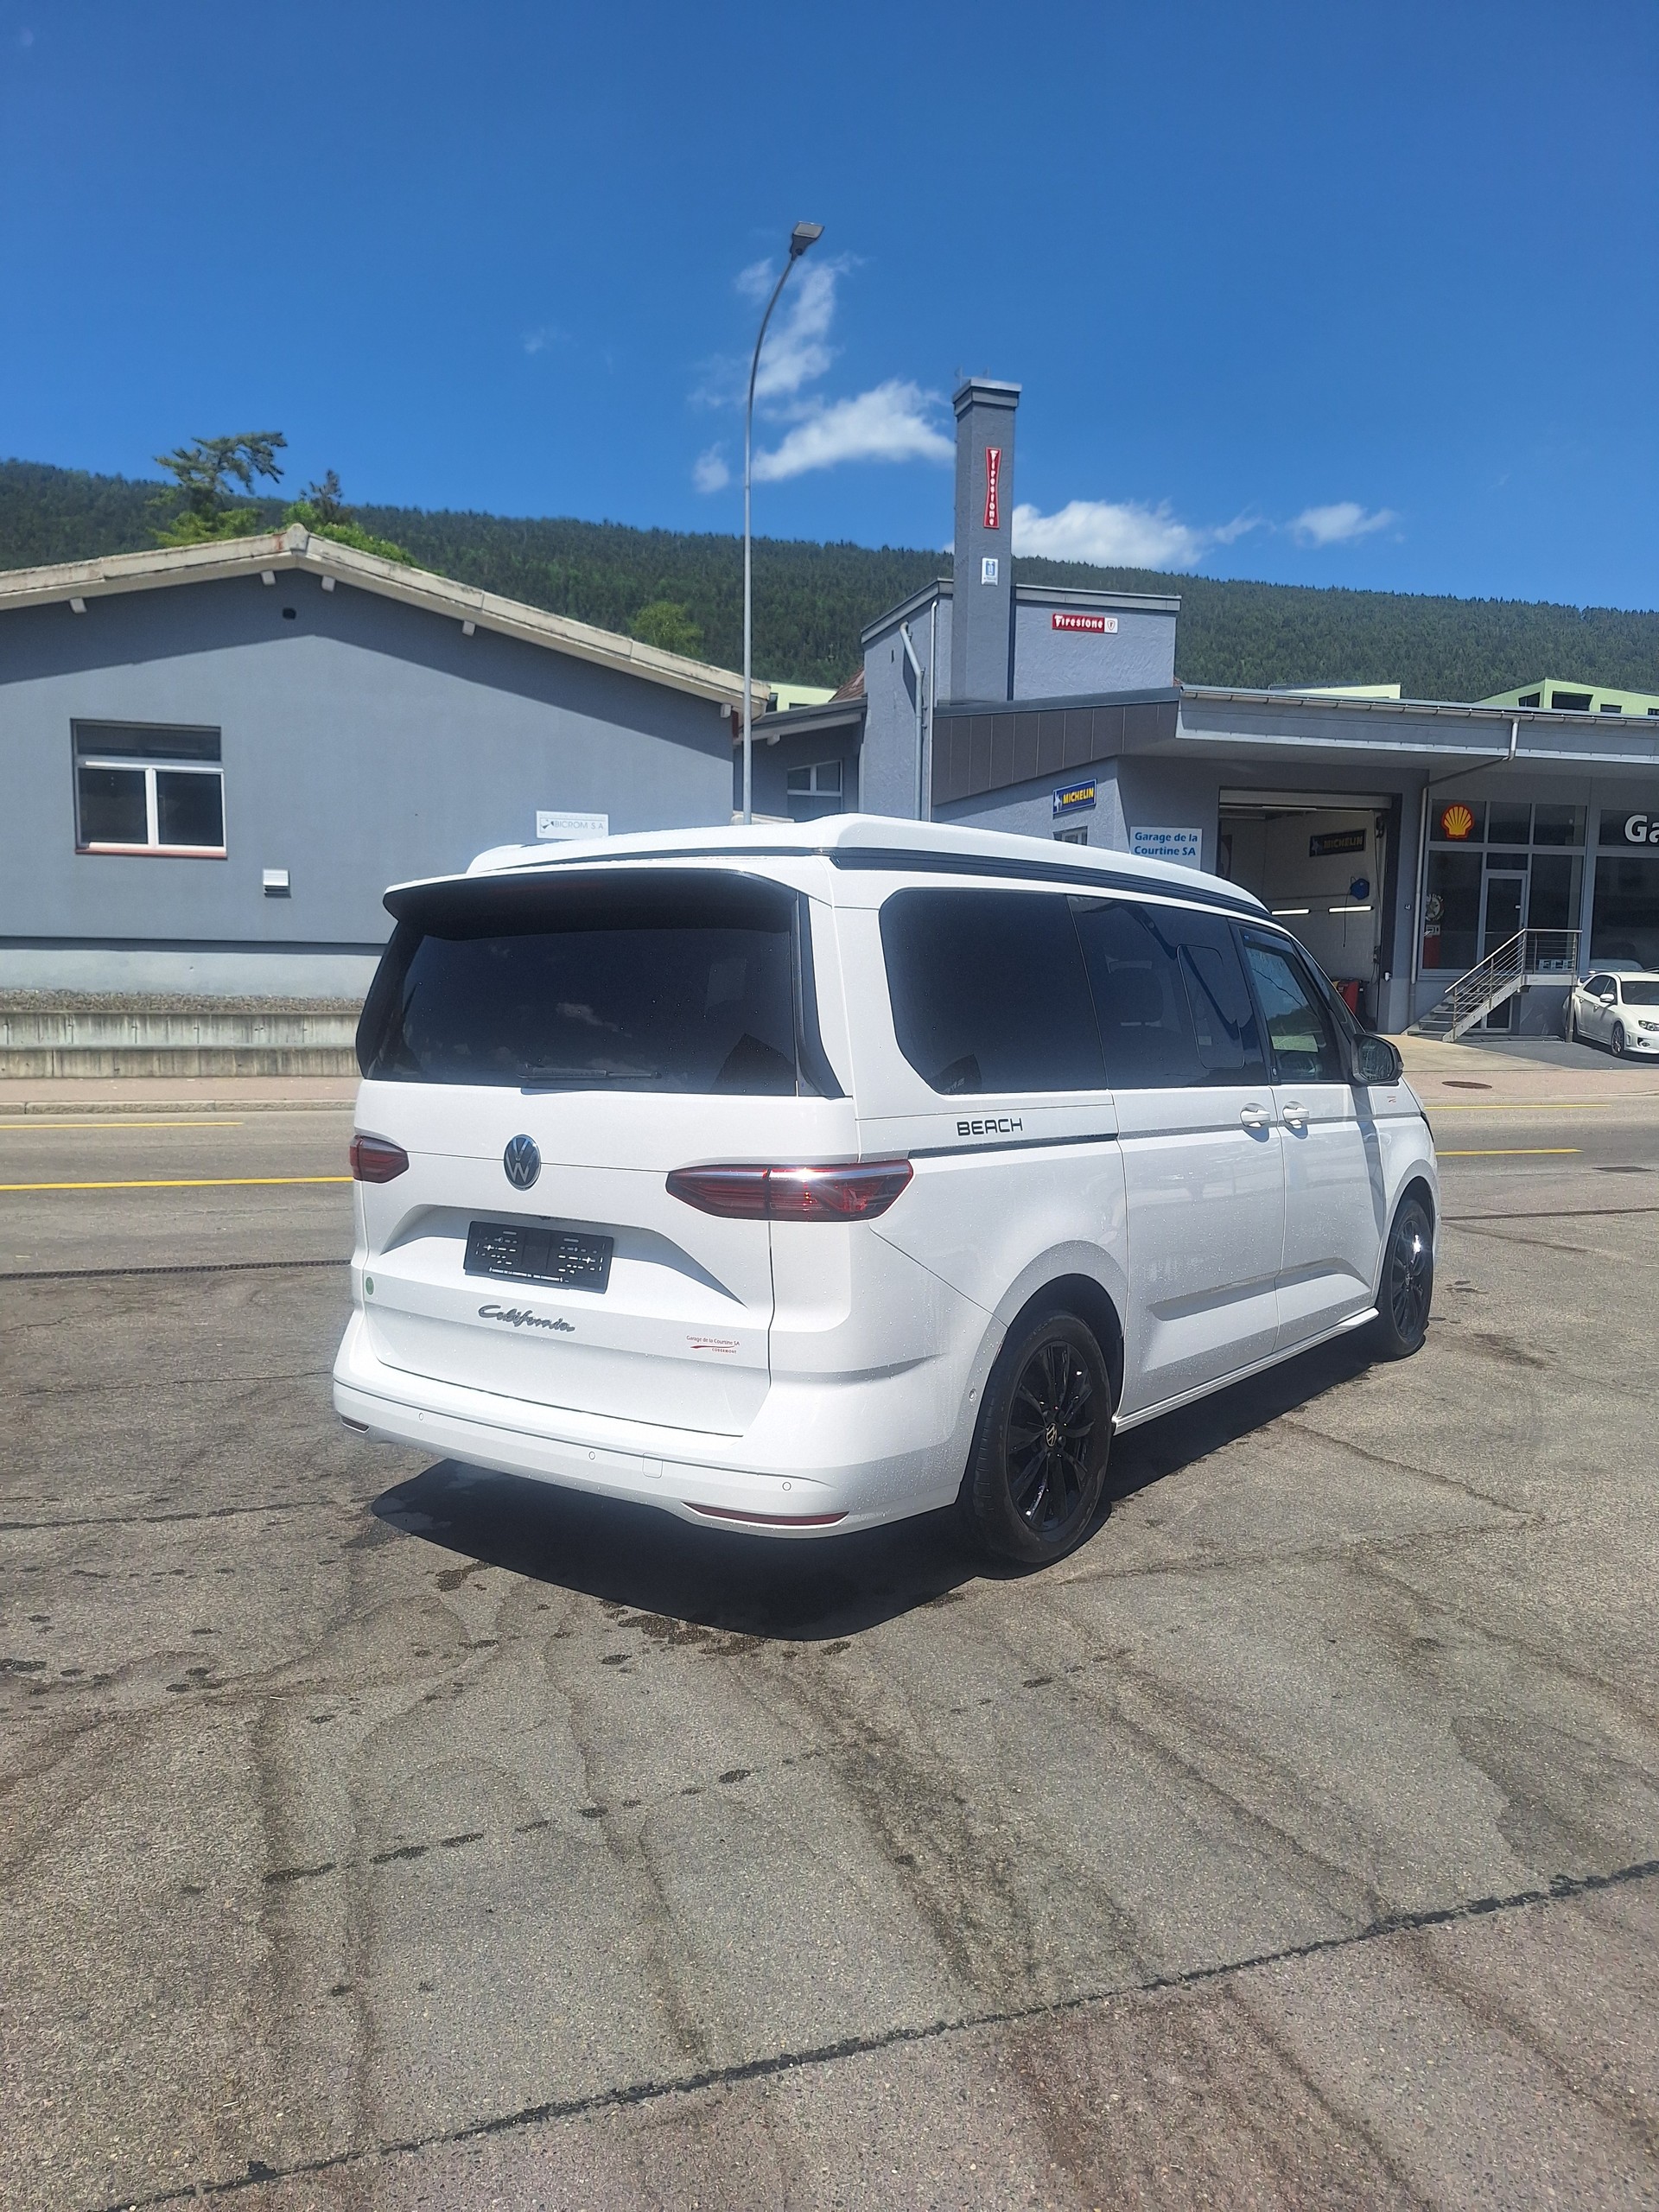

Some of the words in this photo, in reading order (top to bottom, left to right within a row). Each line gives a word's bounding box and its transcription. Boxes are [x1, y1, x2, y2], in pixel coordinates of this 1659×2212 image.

[989, 449, 998, 525] Firestone
[1053, 614, 1104, 630] Firestone
[1063, 787, 1094, 804] MICHELIN
[1135, 831, 1171, 843] Garage
[1173, 832, 1186, 842] de
[1188, 833, 1198, 842] la
[1134, 846, 1180, 855] Courtine
[1181, 847, 1197, 856] SA
[957, 1117, 1023, 1136] BEACH
[478, 1304, 575, 1332] California
